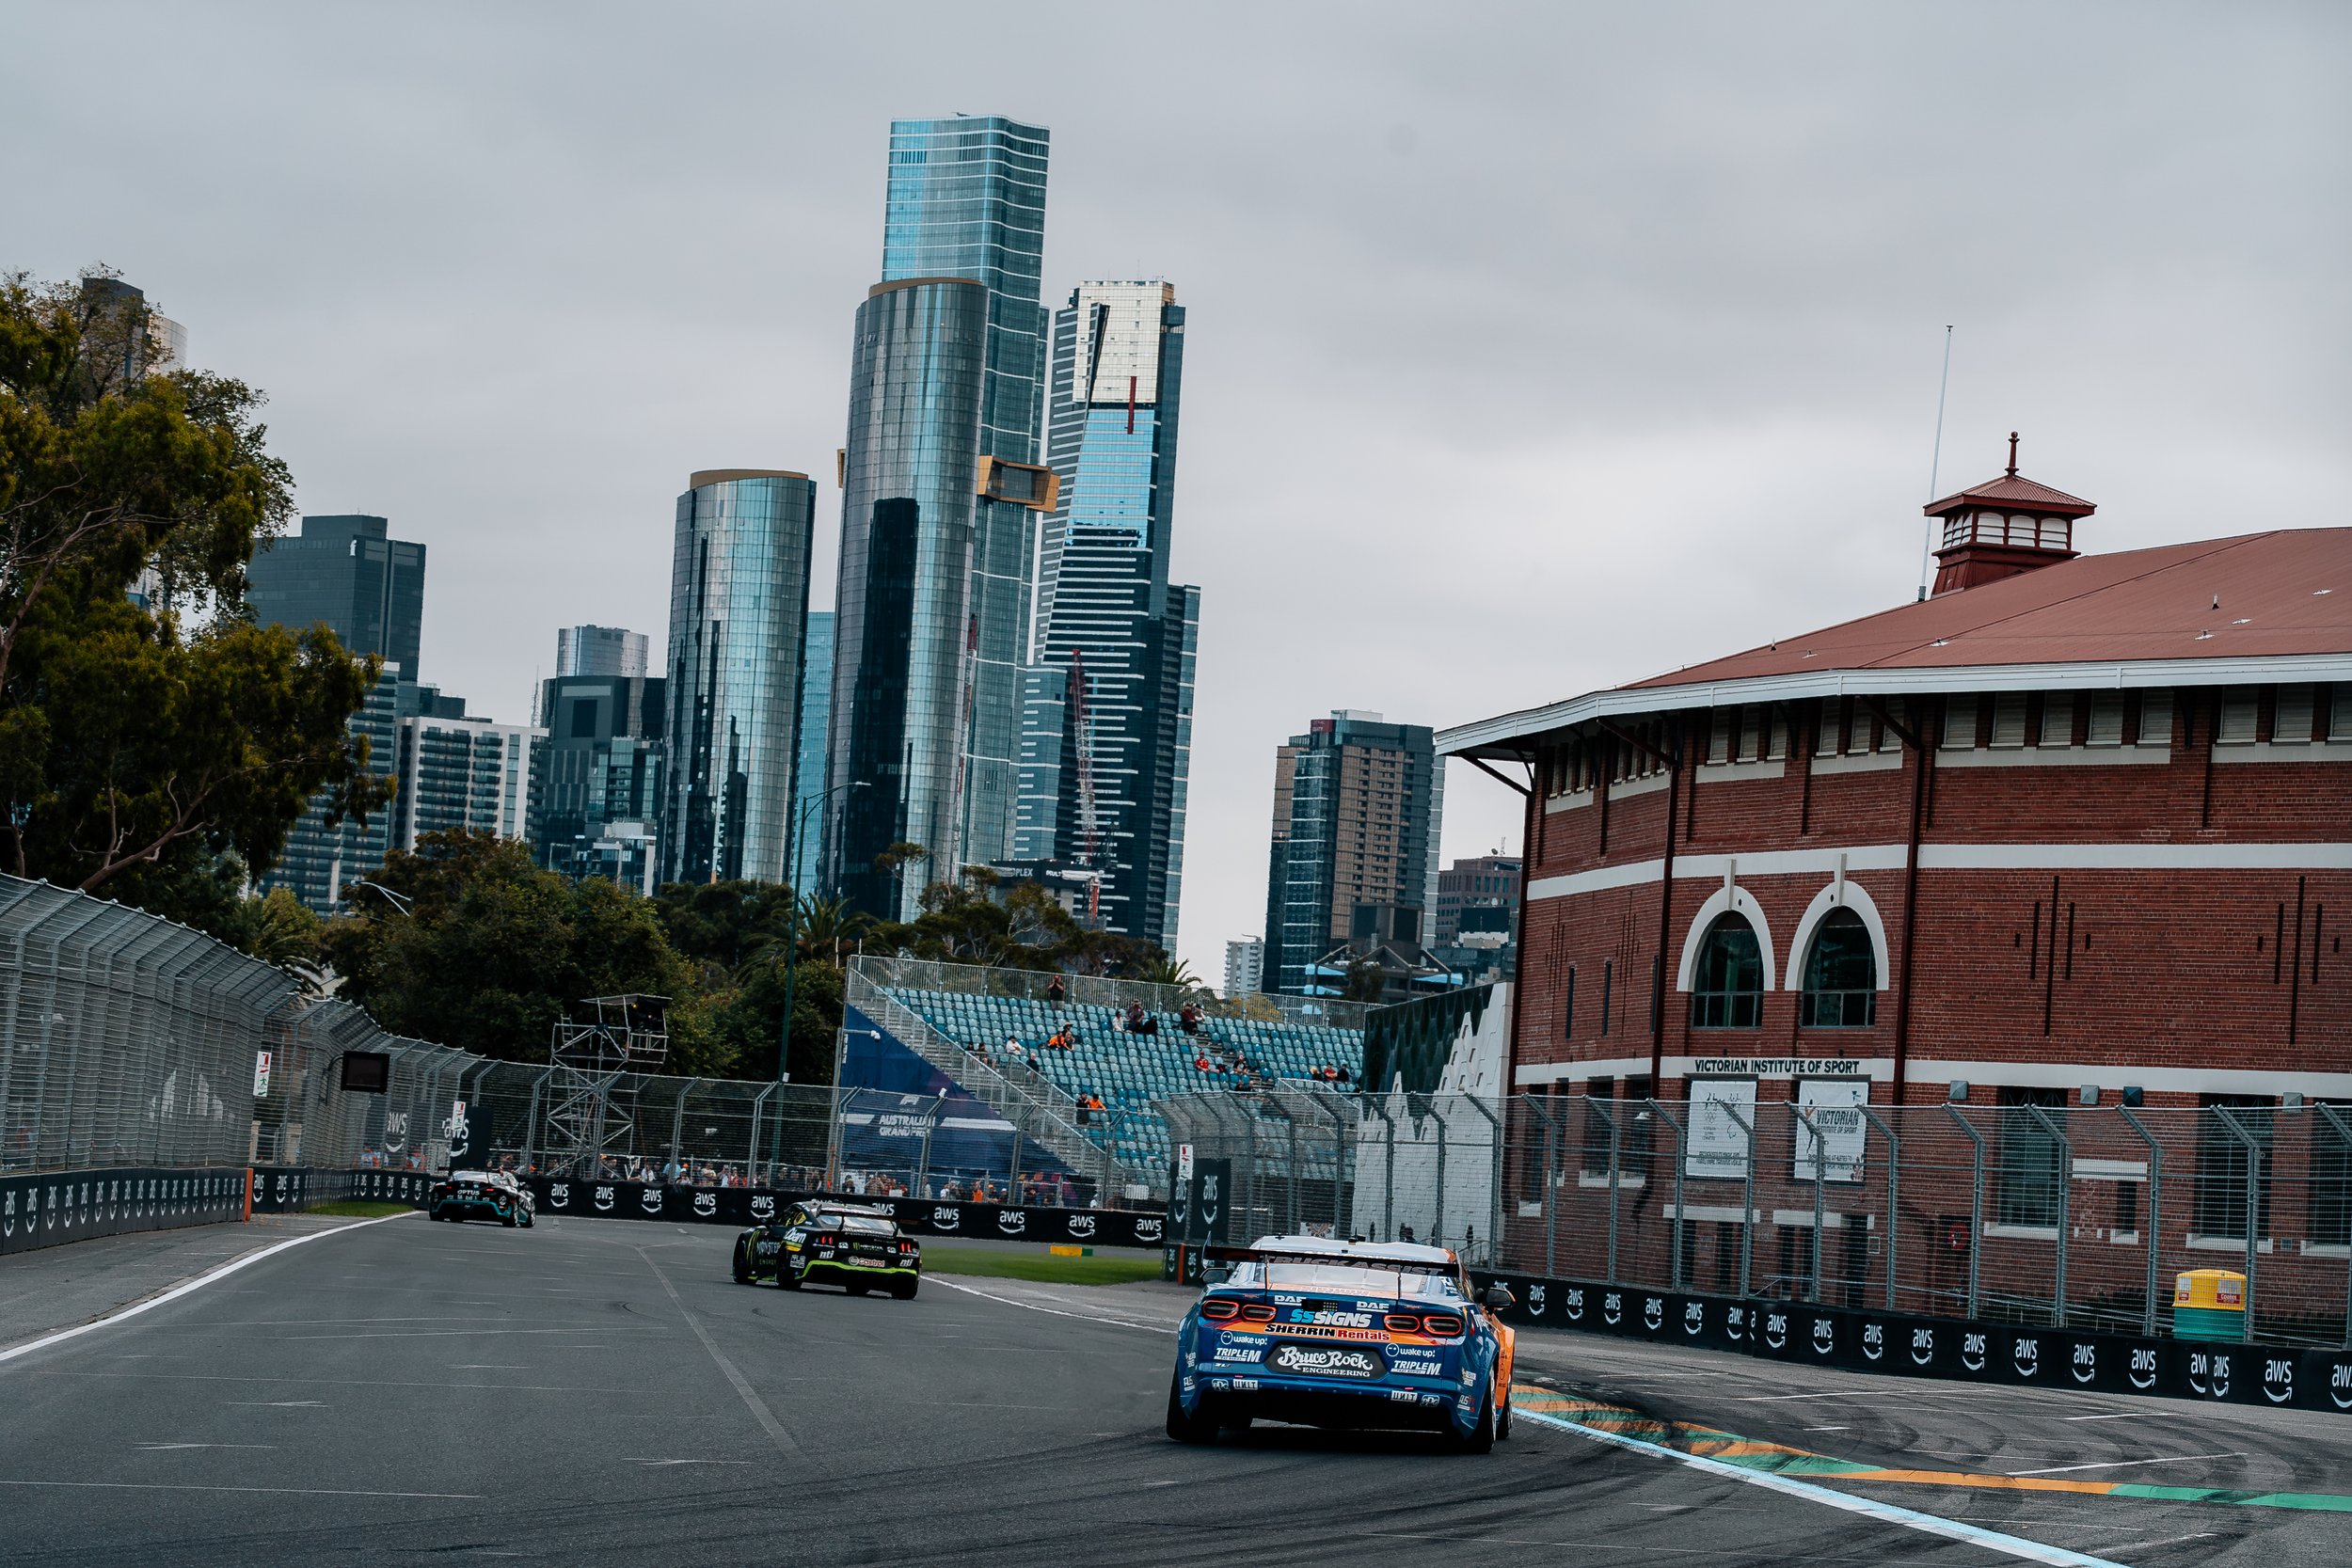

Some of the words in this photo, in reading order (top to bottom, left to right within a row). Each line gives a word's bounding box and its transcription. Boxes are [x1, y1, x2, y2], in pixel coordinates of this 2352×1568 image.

[1694, 1059, 1747, 1072] VICTORIAN
[1751, 1060, 1804, 1073] INSTITUTE
[1807, 1060, 1821, 1073] OF
[1824, 1060, 1859, 1074] SPORT
[879, 1115, 935, 1127] AUSTRALIAN
[1817, 1110, 1859, 1126] VICTORIAN
[879, 1128, 911, 1136] GRAND
[551, 1183, 568, 1196] aws
[596, 1186, 613, 1199] aws
[644, 1189, 661, 1202] aws
[695, 1193, 715, 1206] aws
[752, 1196, 773, 1210] aws
[934, 1207, 959, 1221] aws
[998, 1212, 1025, 1225] aws
[1070, 1215, 1095, 1229] aws
[1136, 1219, 1161, 1232] aws
[819, 1250, 834, 1259] nti
[858, 1258, 884, 1268] Castrol
[899, 1259, 914, 1267] nti
[1260, 1254, 1349, 1267] TRUCK
[1351, 1261, 1443, 1275] ASSIST
[1530, 1285, 1545, 1301] aws
[1567, 1290, 1582, 1306] aws
[1357, 1301, 1389, 1309] DAF
[1605, 1293, 1621, 1310] aws
[1645, 1298, 1662, 1315] aws
[1685, 1303, 1703, 1321] aws
[1264, 1323, 1335, 1337] SHERRIN
[1337, 1329, 1391, 1340] Rentals
[1768, 1314, 1787, 1333] aws
[1814, 1319, 1832, 1338] aws
[1864, 1324, 1882, 1343] aws
[1914, 1329, 1932, 1348] aws
[1400, 1347, 1422, 1356] wake
[1964, 1333, 1985, 1354] aws
[2016, 1338, 2037, 1359] aws
[1216, 1348, 1248, 1357] TRIPLE
[1247, 1350, 1262, 1363] M
[1278, 1346, 1327, 1367] Bruce
[1327, 1351, 1373, 1370] Rock
[2074, 1343, 2094, 1365] aws
[2132, 1349, 2155, 1370] aws
[1302, 1367, 1370, 1378] ENGINEERING
[1393, 1360, 1428, 1370] TRIPLE
[1426, 1363, 1441, 1376] M
[2191, 1354, 2206, 1375] aw
[2214, 1355, 2230, 1378] aws
[2265, 1360, 2292, 1384] aws
[2332, 1365, 2352, 1387] aw
